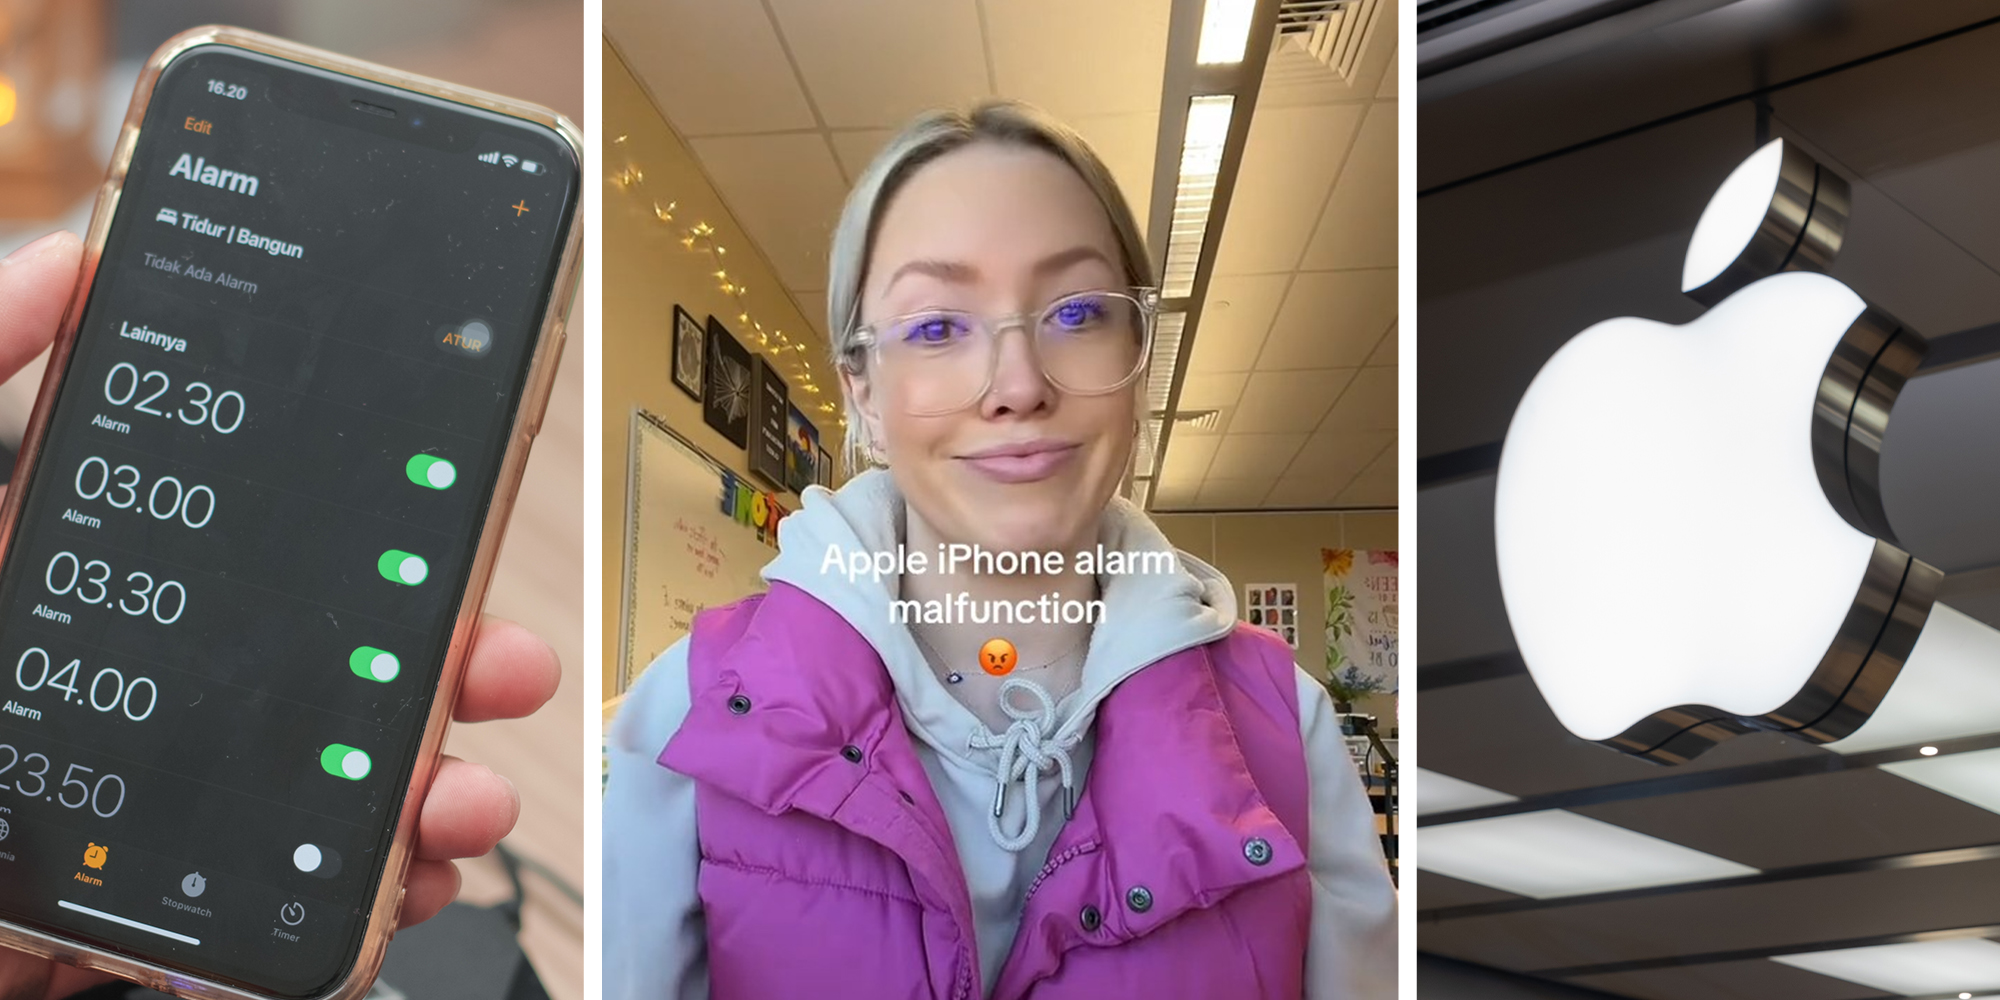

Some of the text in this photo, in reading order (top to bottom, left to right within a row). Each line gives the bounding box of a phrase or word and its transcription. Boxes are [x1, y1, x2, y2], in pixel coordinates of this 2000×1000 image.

[207, 79, 248, 100] 16.20
[184, 116, 213, 136] Edit
[169, 153, 260, 197] Alarm
[181, 213, 226, 239] Tidur
[236, 228, 304, 259] Bangun
[143, 252, 258, 294] Tidak Ada Alarm
[119, 321, 188, 353] Lainnya
[442, 332, 482, 353] ATUR
[104, 362, 246, 434] 02.30
[91, 414, 131, 434] Alarm
[75, 456, 216, 529] 03.00
[61, 508, 102, 529] Alarm
[45, 551, 187, 625] 03.30
[32, 603, 72, 625] Alarm
[15, 647, 158, 721] 04.00
[2, 700, 42, 721] Alarm
[0, 744, 126, 818] 23.50
[74, 871, 103, 887] Alarm
[161, 896, 213, 918] Stopwatch
[272, 927, 300, 943] Timer
